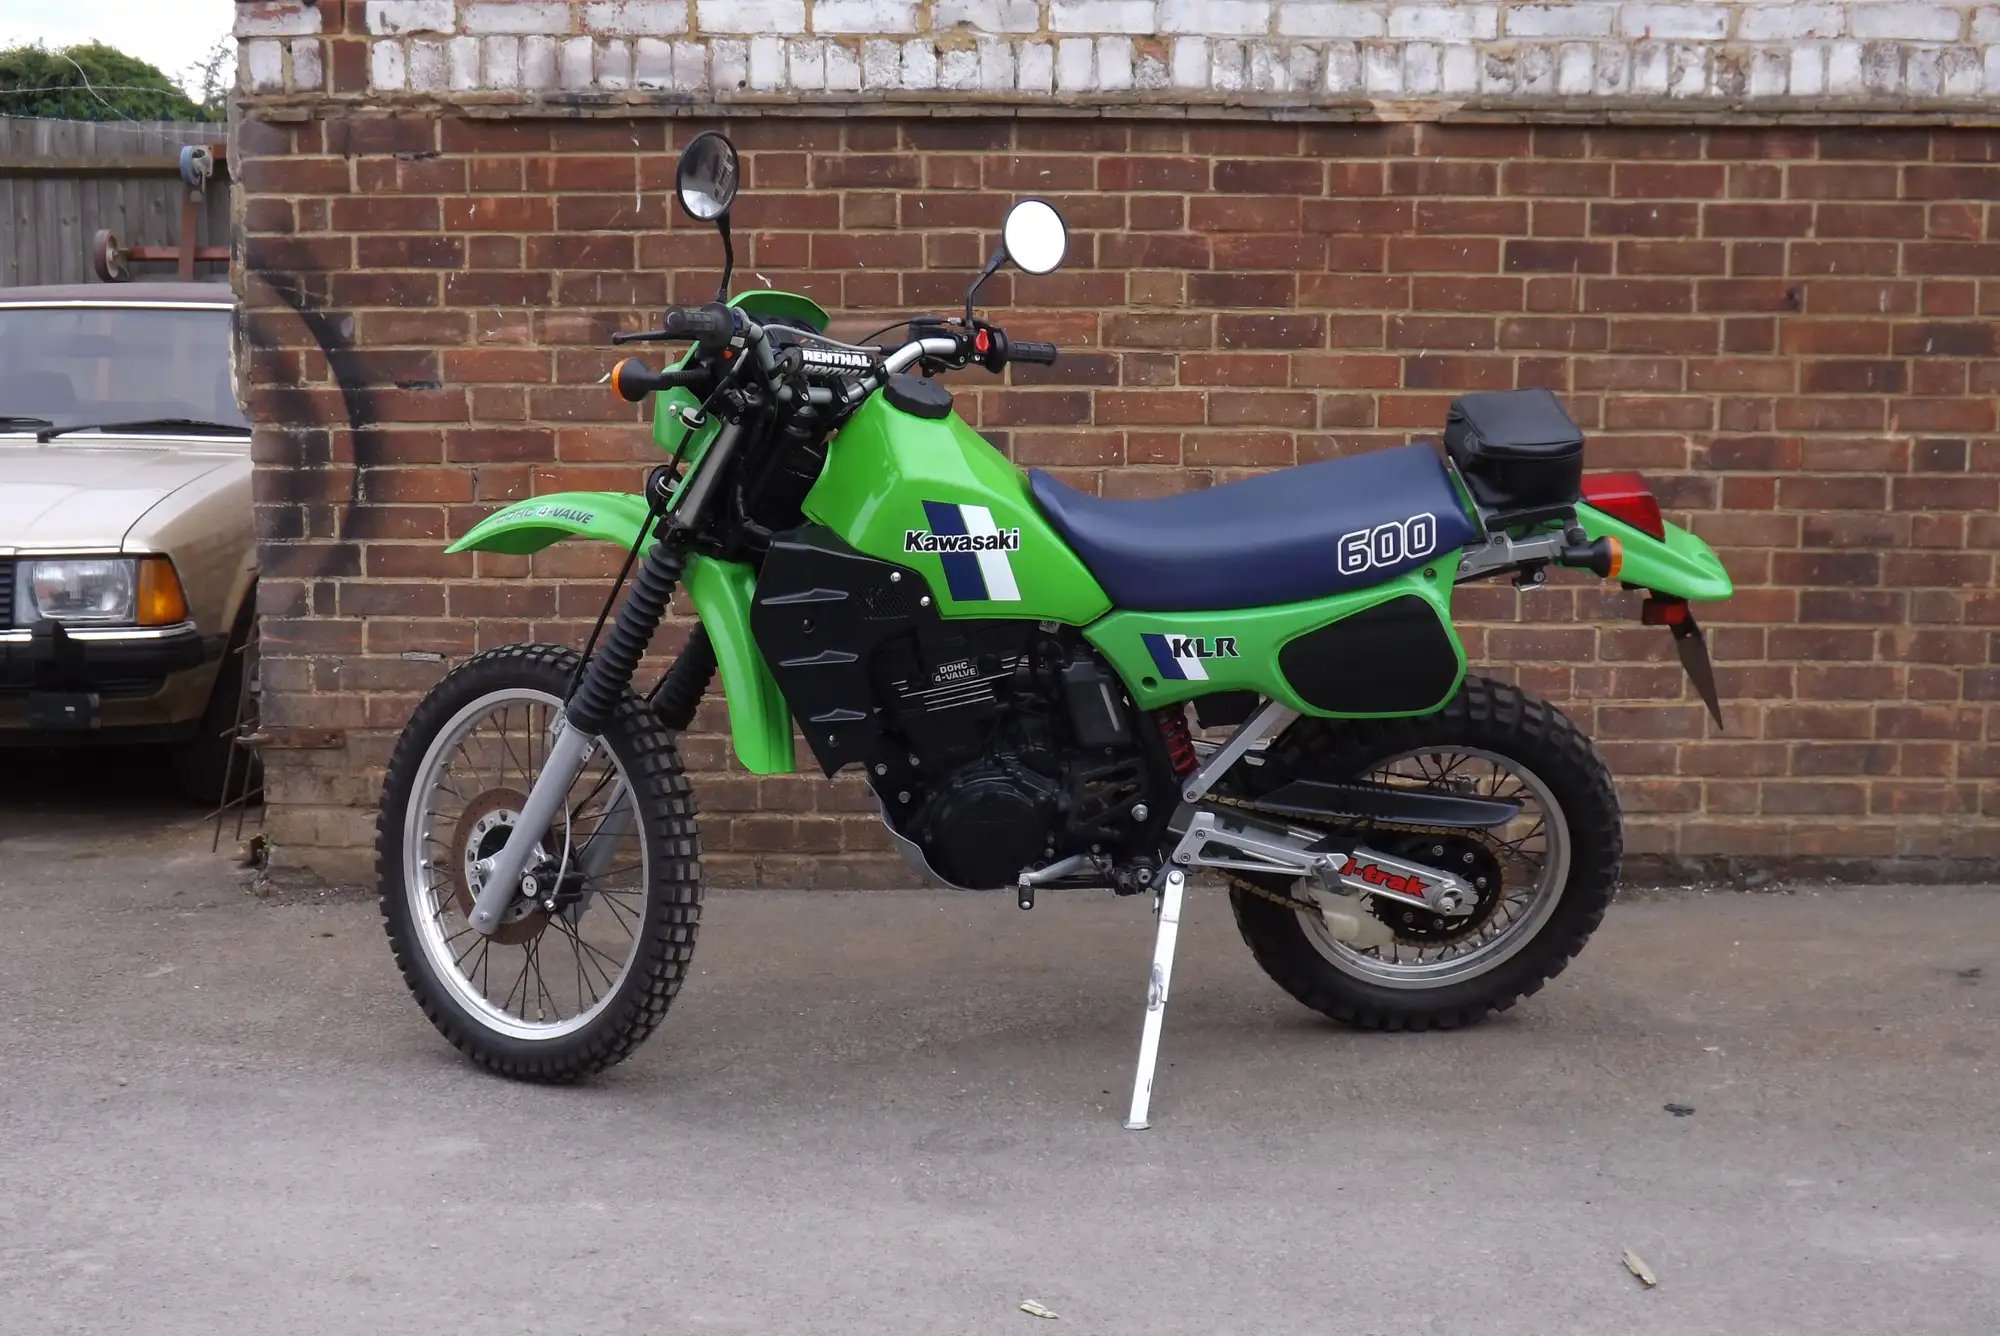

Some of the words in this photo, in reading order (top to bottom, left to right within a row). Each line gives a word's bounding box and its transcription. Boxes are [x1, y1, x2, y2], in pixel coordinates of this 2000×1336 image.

[802, 350, 872, 367] RENTHAL
[538, 507, 594, 524] 4-VALVE
[904, 528, 1019, 552] Kawasaki
[1338, 512, 1436, 575] 600
[1172, 636, 1240, 658] KLR
[934, 667, 977, 682] 4-VALVE
[940, 661, 968, 674] DOHC
